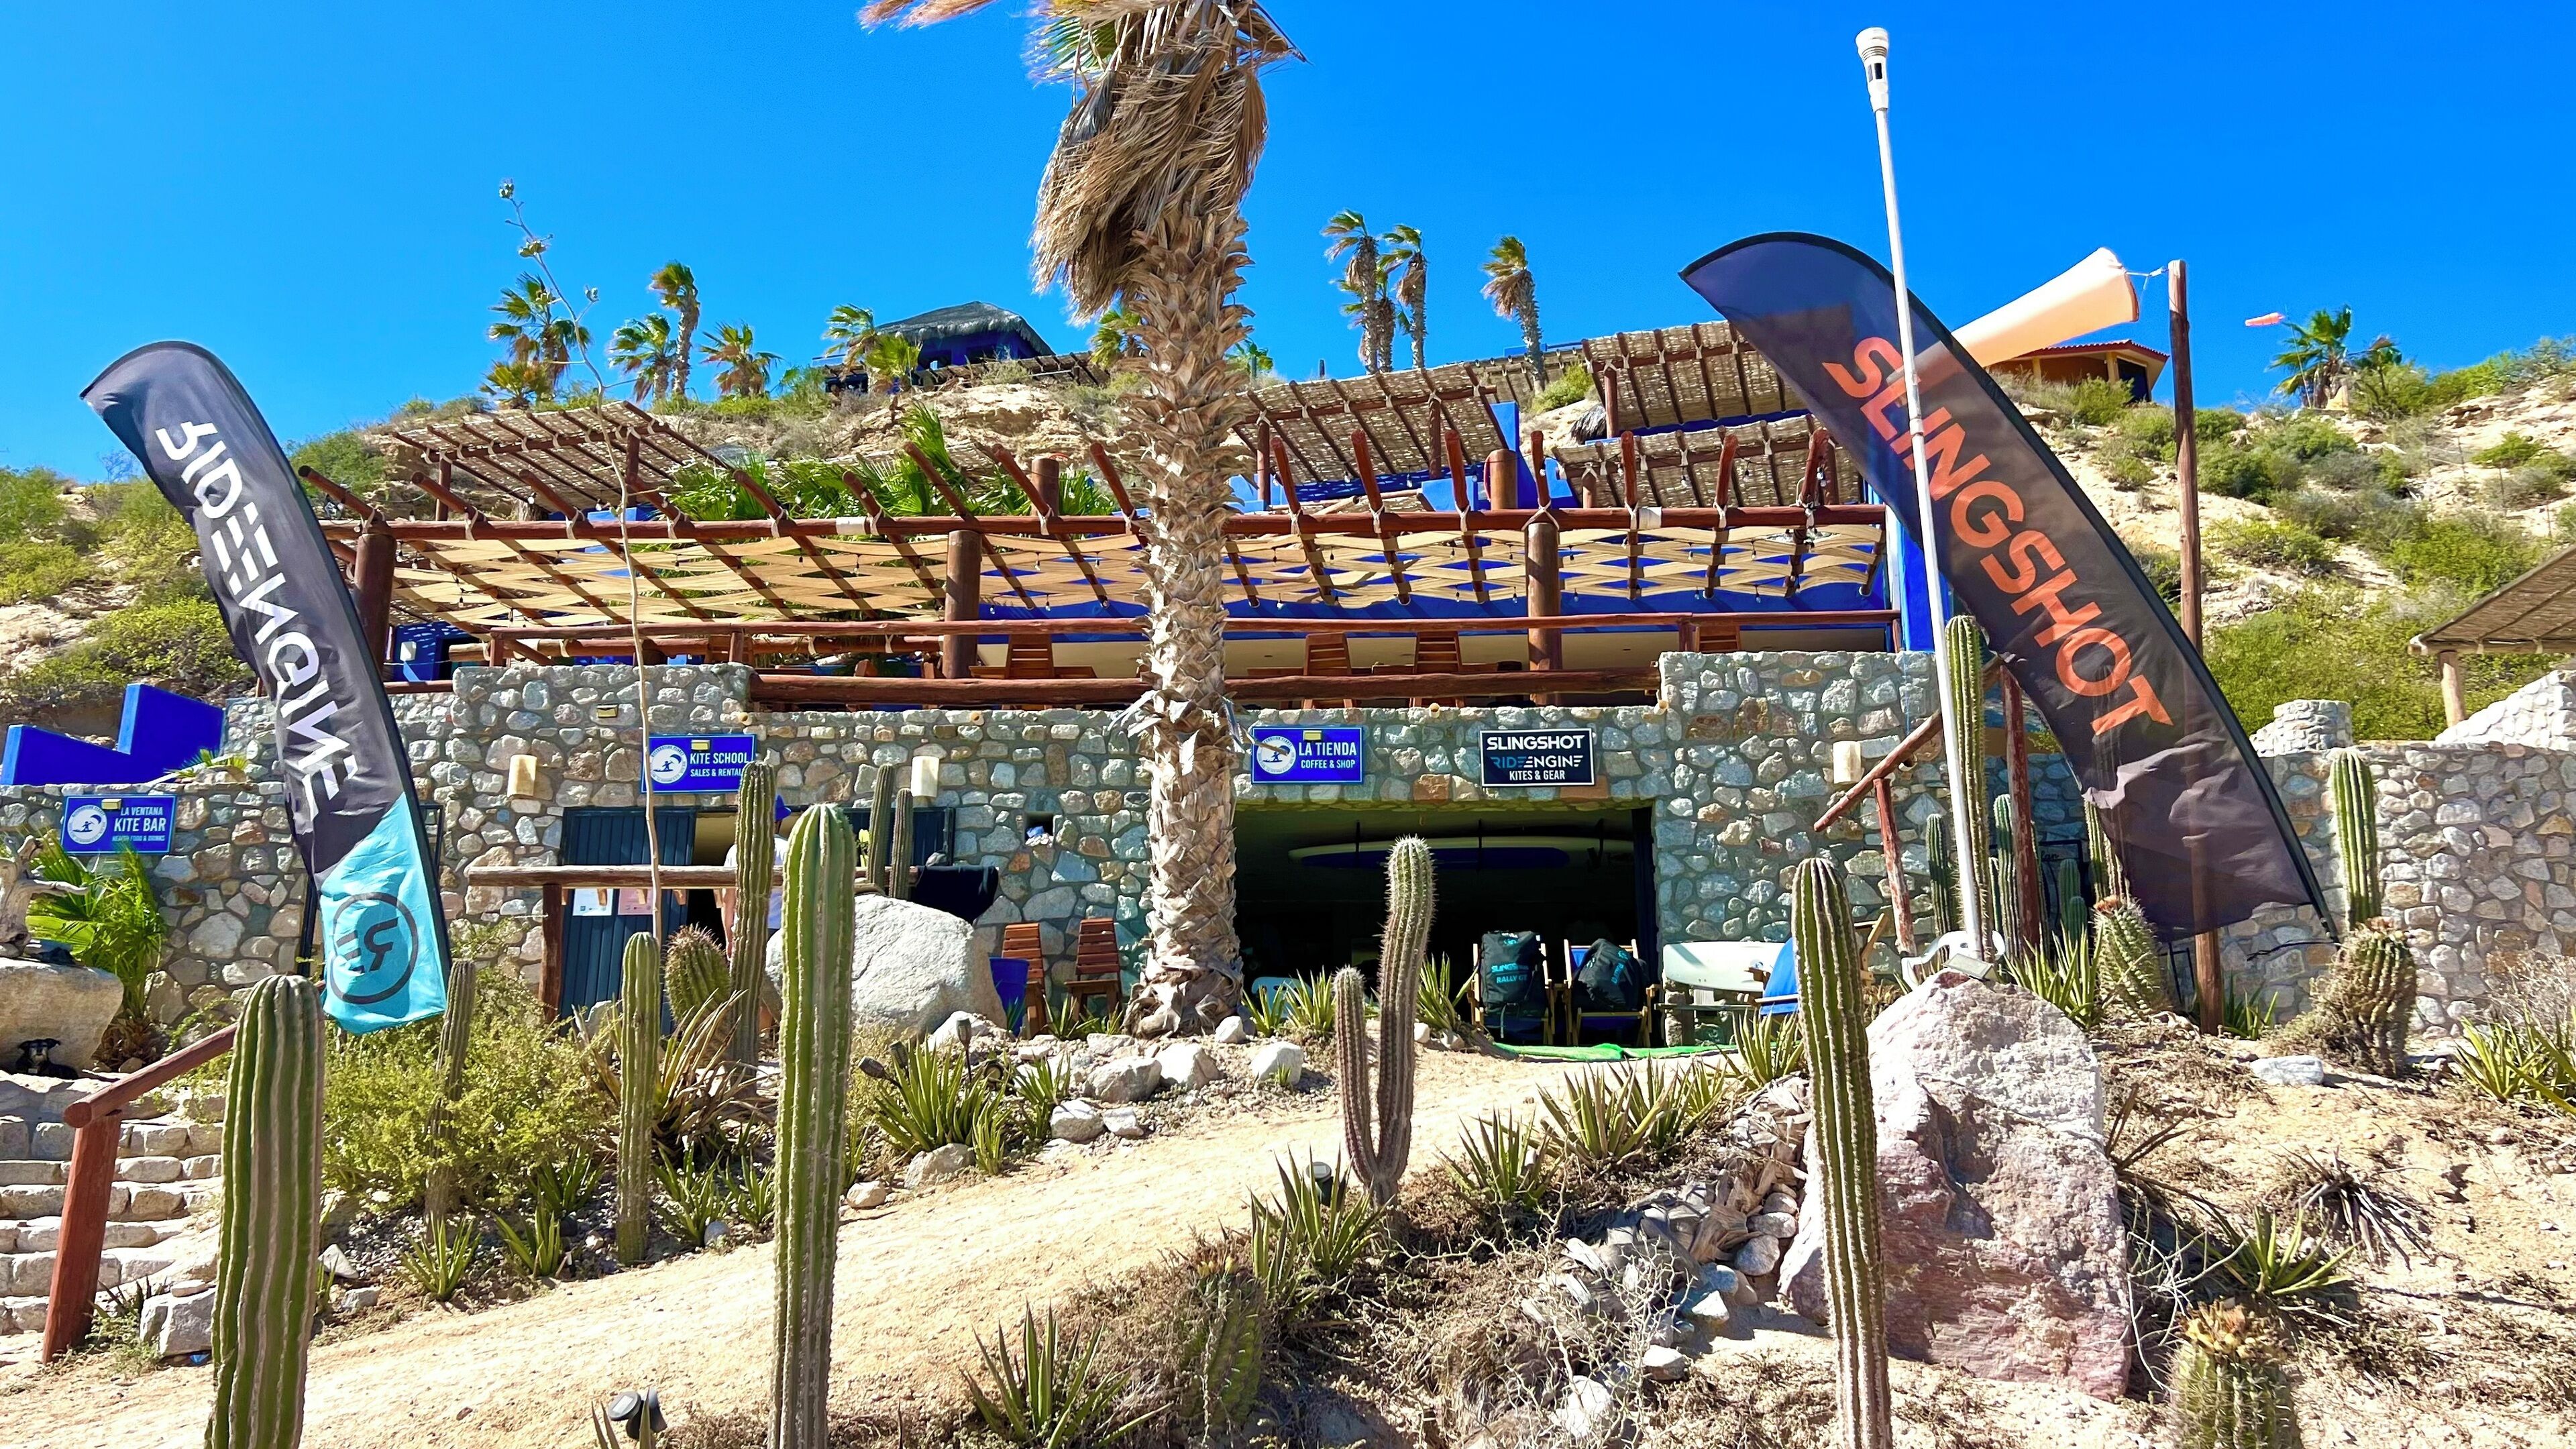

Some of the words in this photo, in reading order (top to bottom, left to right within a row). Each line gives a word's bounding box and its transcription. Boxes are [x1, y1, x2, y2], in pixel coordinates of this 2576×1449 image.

[1822, 337, 2174, 736] SLINGSHOT
[1487, 735, 1585, 751] SLINGSHOT
[1299, 742, 1312, 756] LA
[1316, 742, 1356, 756] TIENDA
[690, 752, 710, 764] KITE
[713, 752, 749, 763] SCHOOL
[1301, 759, 1328, 769] COFFEE
[1330, 759, 1335, 769] &
[1336, 759, 1356, 769] SHOP
[690, 768, 710, 777] SALES
[712, 768, 716, 776] &
[718, 767, 742, 777] RENTAL
[1509, 770, 1533, 781] KITES
[1534, 770, 1542, 780] &
[1543, 770, 1565, 780] GEAR
[120, 806, 129, 816] LA
[131, 806, 163, 816] VENTANA
[114, 817, 141, 832] KITE
[143, 817, 166, 832] BAR
[1497, 975, 1517, 983] RALLY
